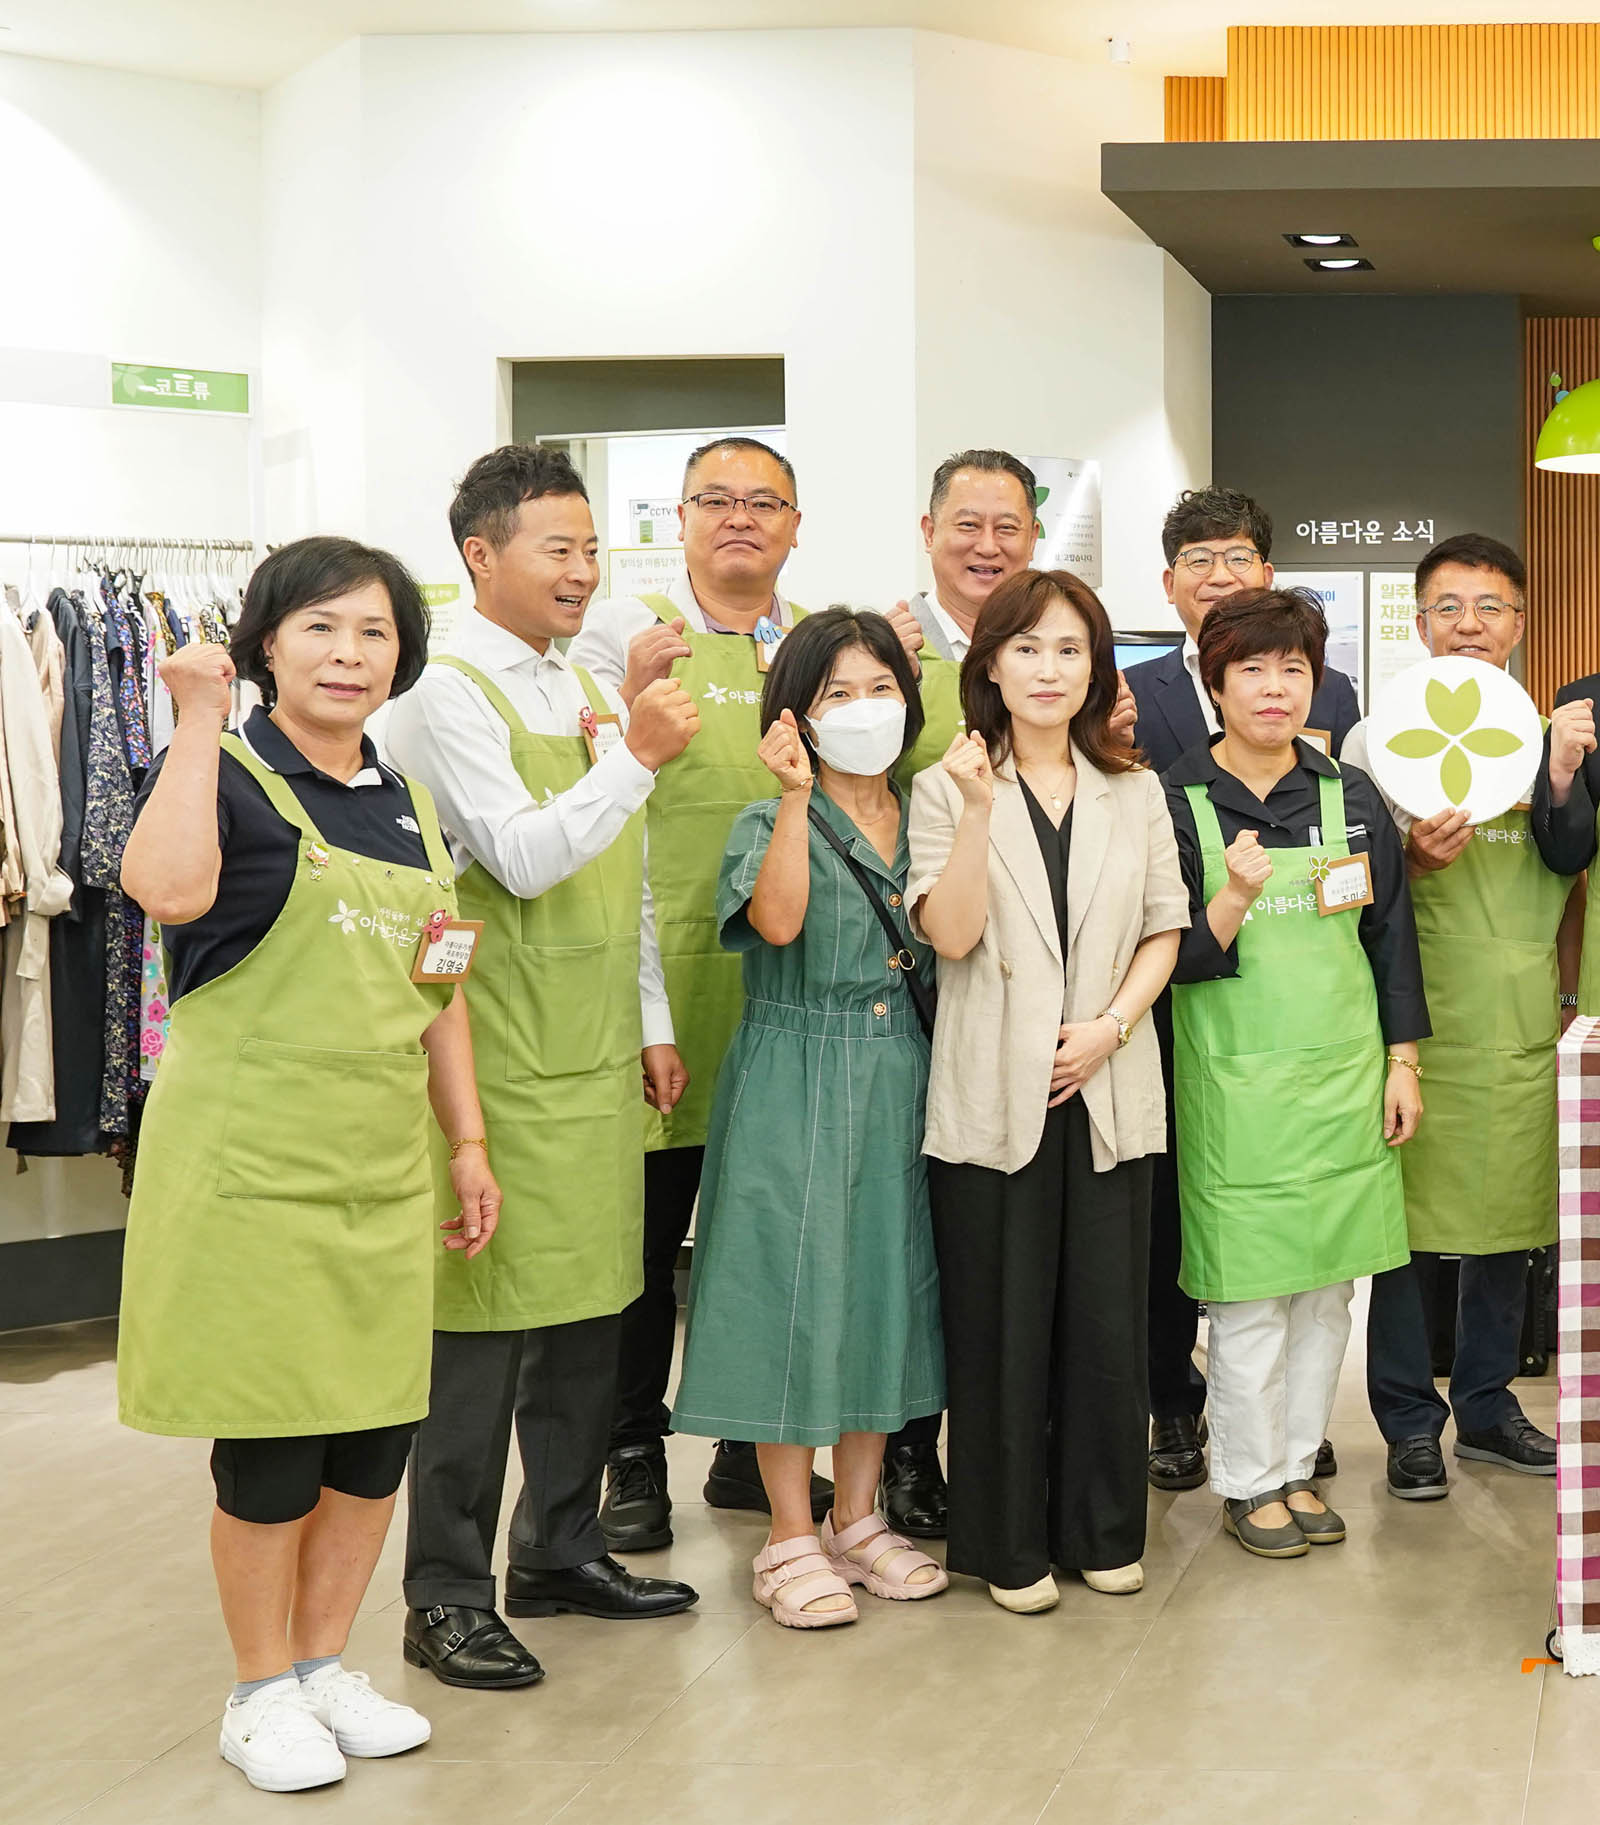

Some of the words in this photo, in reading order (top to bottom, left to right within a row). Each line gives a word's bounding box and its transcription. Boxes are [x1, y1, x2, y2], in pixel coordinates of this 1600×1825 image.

[155, 379, 211, 400] 코트류
[650, 508, 671, 517] CCTV
[1296, 519, 1385, 545] 아름다운
[1391, 519, 1434, 545] 소식
[1381, 625, 1410, 641] 모집
